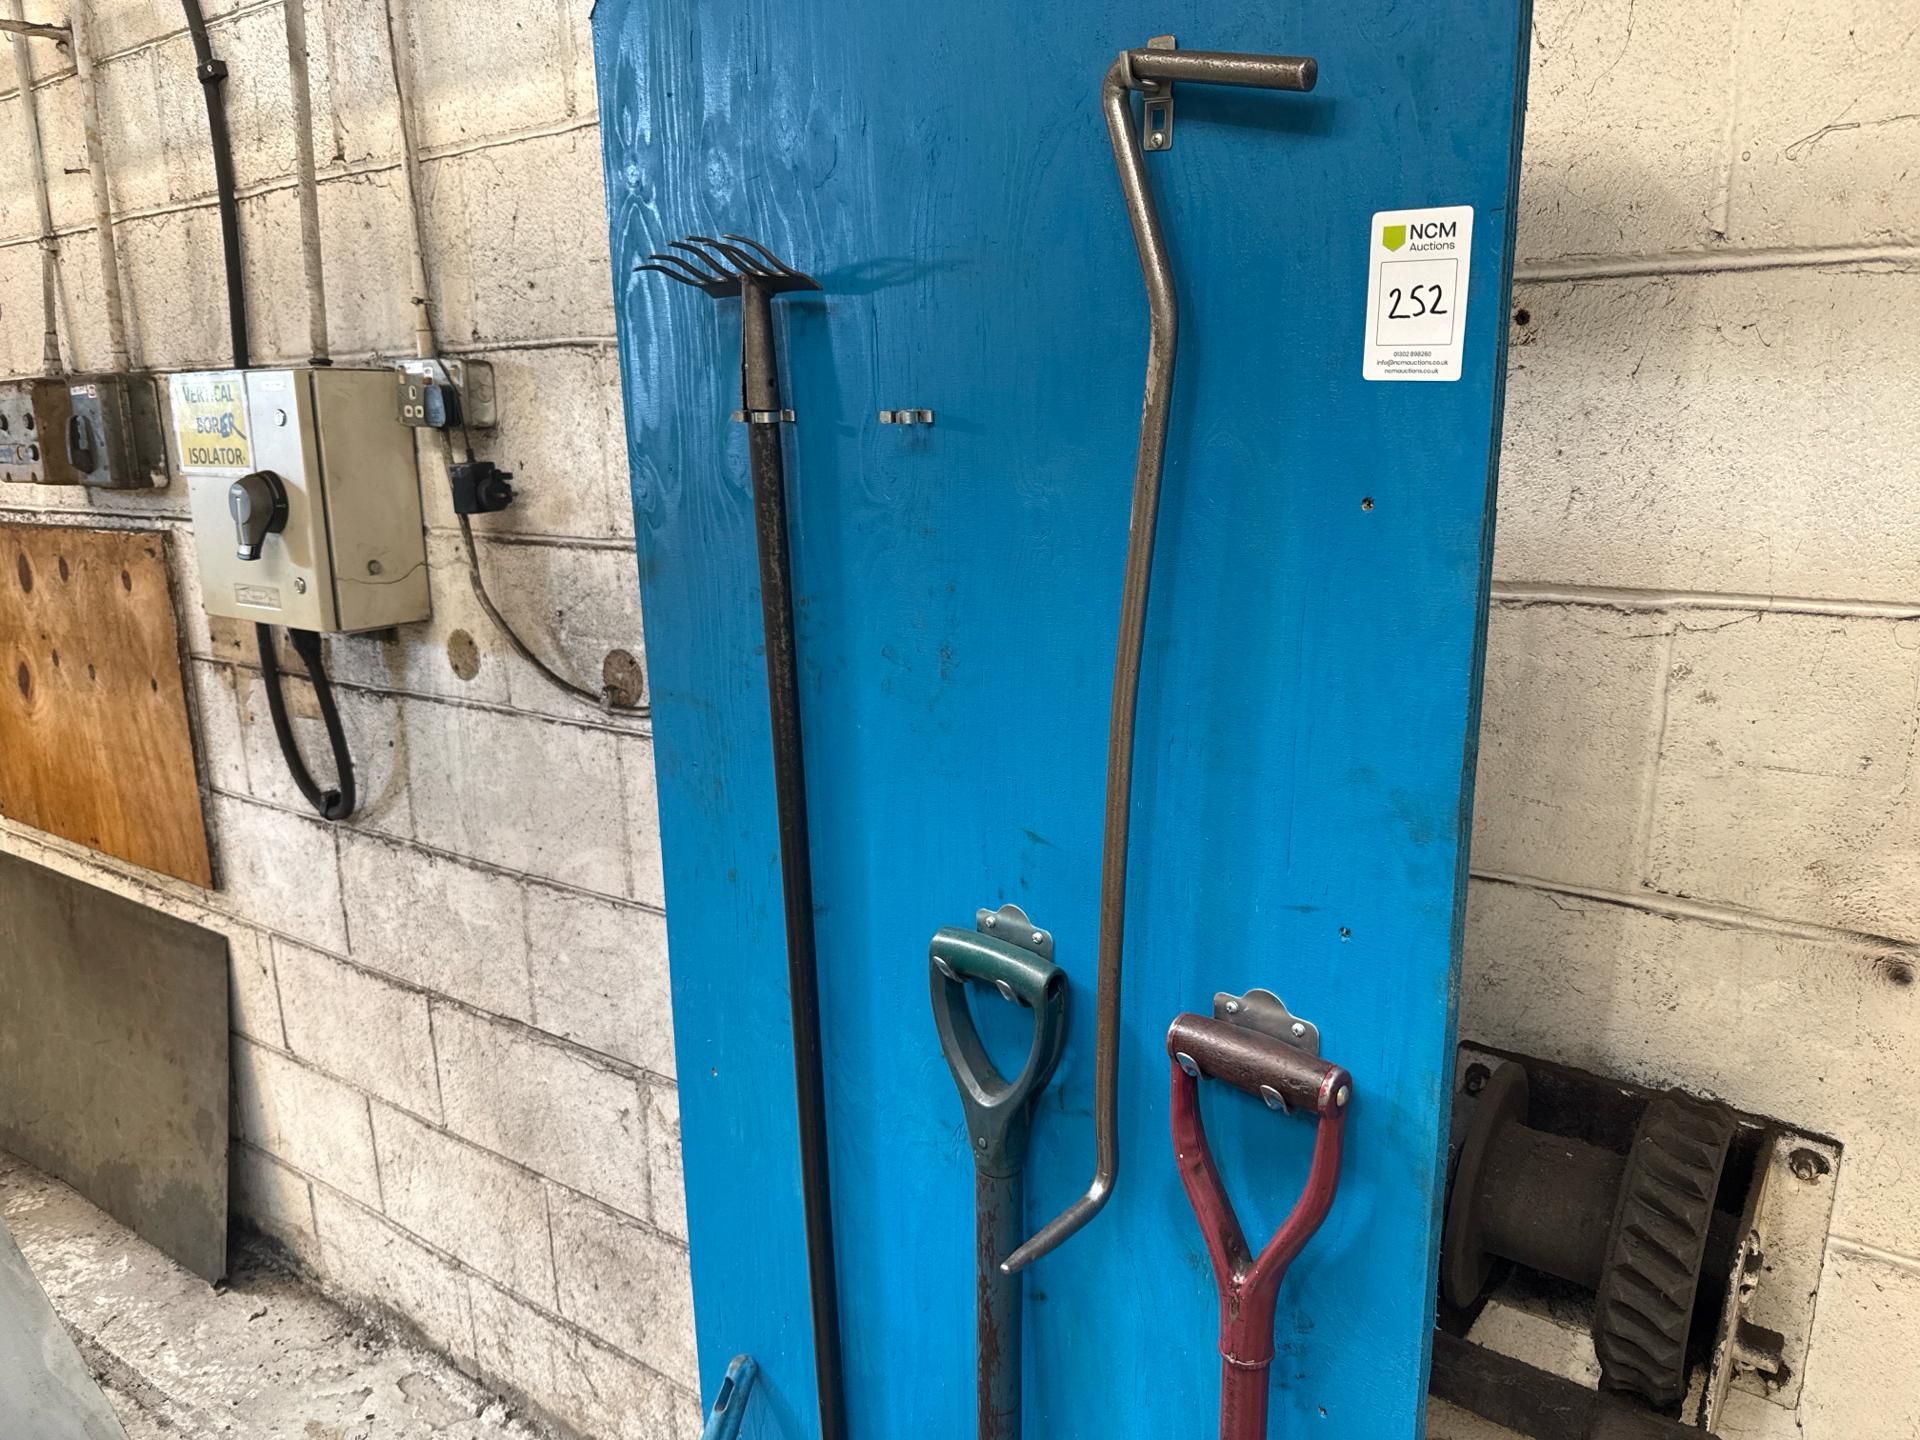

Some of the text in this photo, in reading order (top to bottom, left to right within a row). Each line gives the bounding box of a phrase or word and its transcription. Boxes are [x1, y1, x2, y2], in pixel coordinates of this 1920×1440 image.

[1410, 221, 1456, 240] NCM
[1409, 241, 1455, 252] Auctions
[1388, 284, 1447, 319] 252
[1376, 359, 1448, 367] info@ncmauctions.co.uk
[188, 447, 244, 465] ISOLATOR
